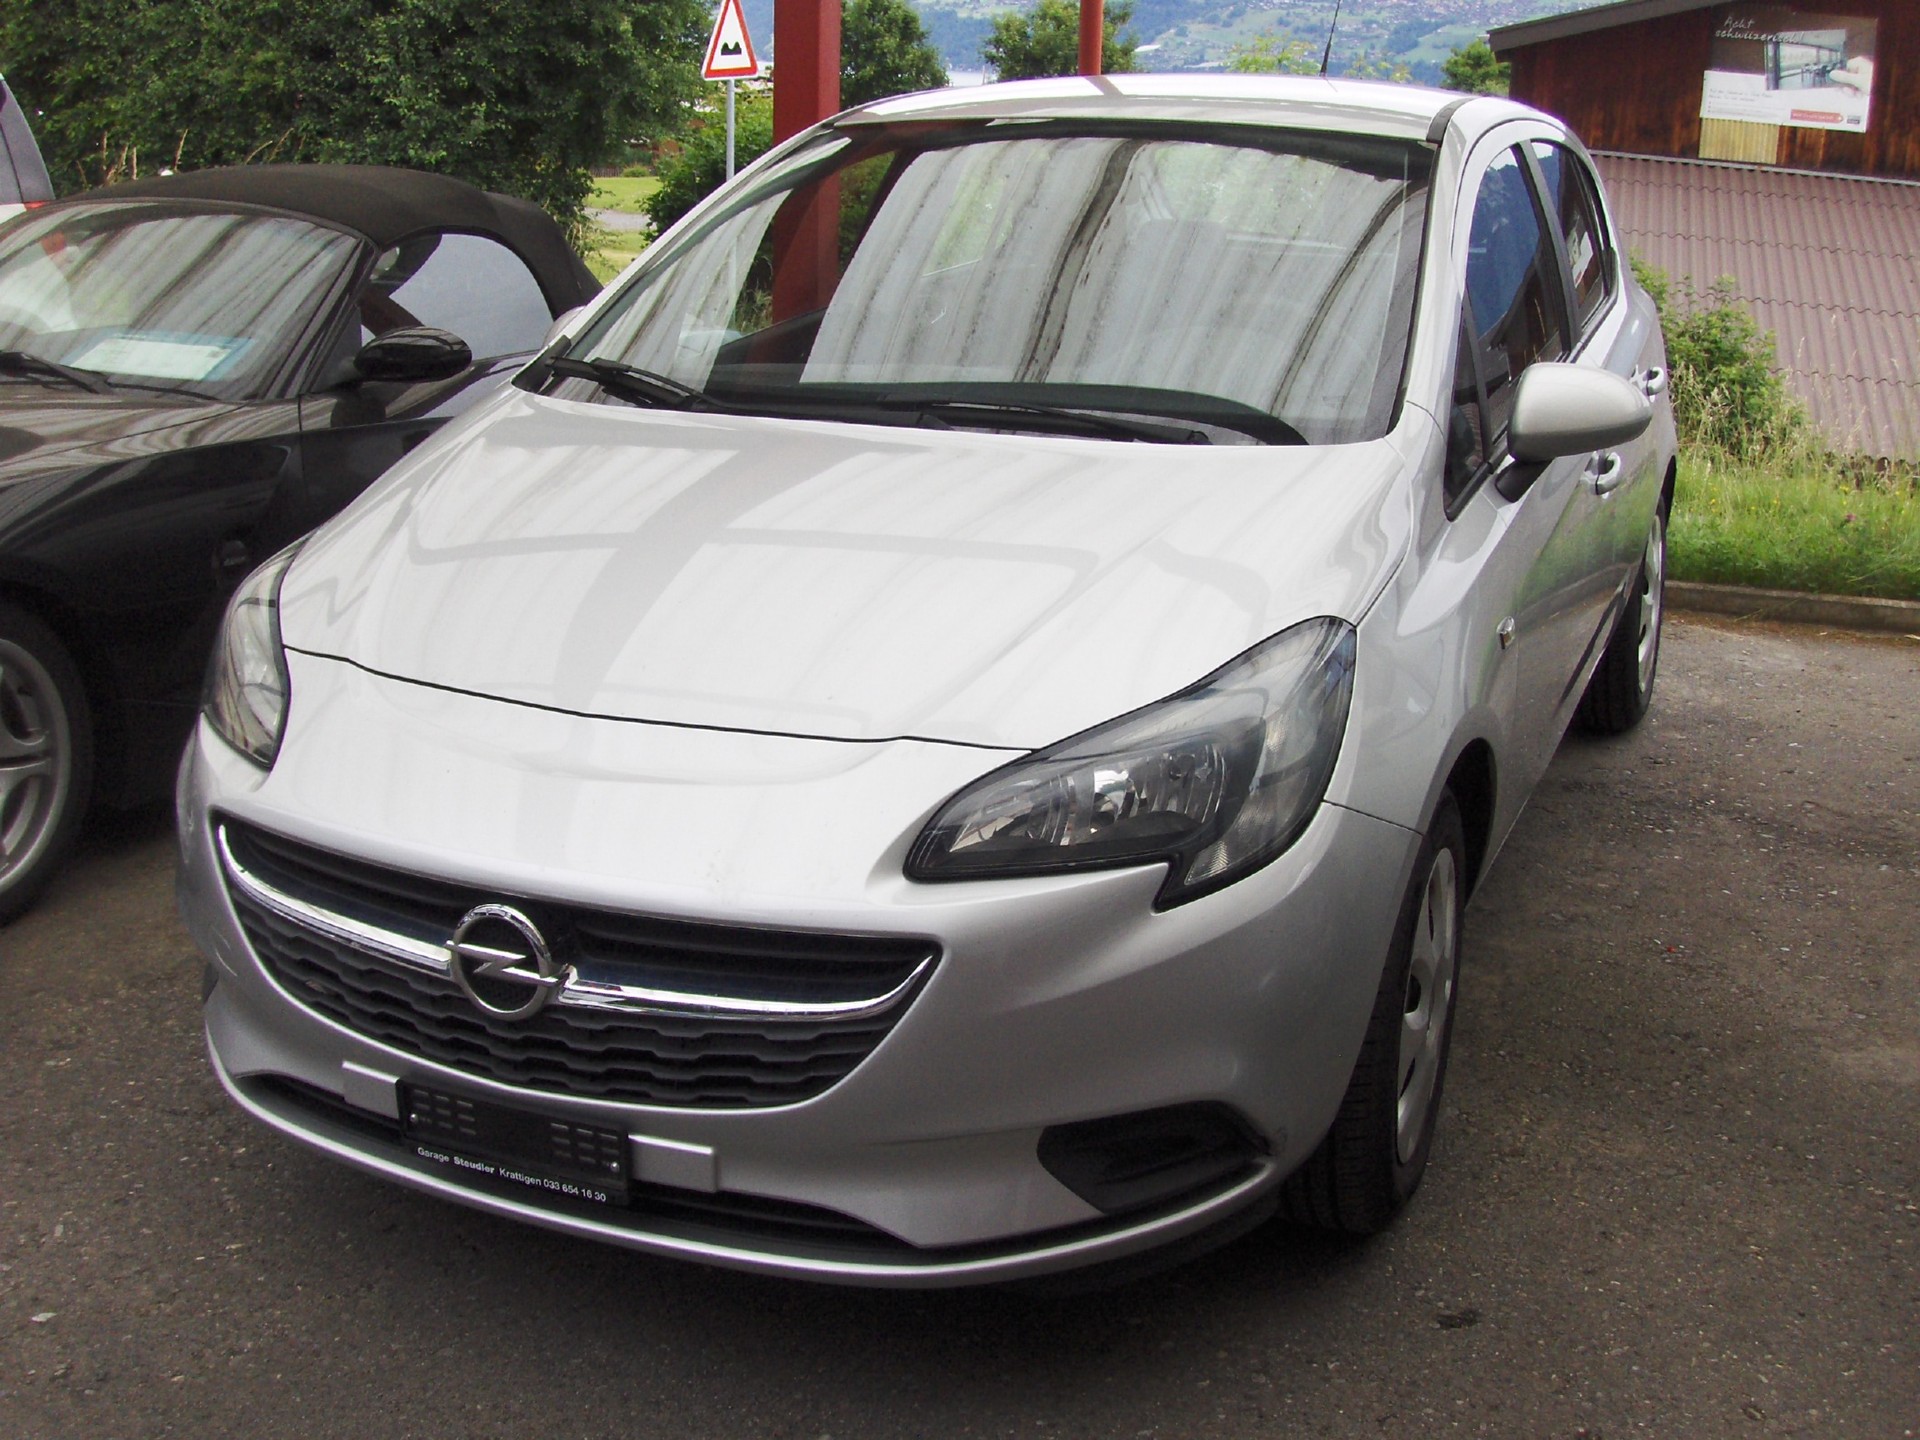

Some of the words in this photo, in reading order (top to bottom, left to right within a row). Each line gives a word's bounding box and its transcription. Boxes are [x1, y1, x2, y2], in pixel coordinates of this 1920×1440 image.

[417, 1146, 450, 1163] Garage
[453, 1156, 495, 1174] Steudler
[499, 1167, 542, 1186] Krattigen
[543, 1178, 560, 1191] 033
[562, 1184, 579, 1197] 654
[581, 1188, 592, 1200] 16
[594, 1191, 606, 1203] 30
